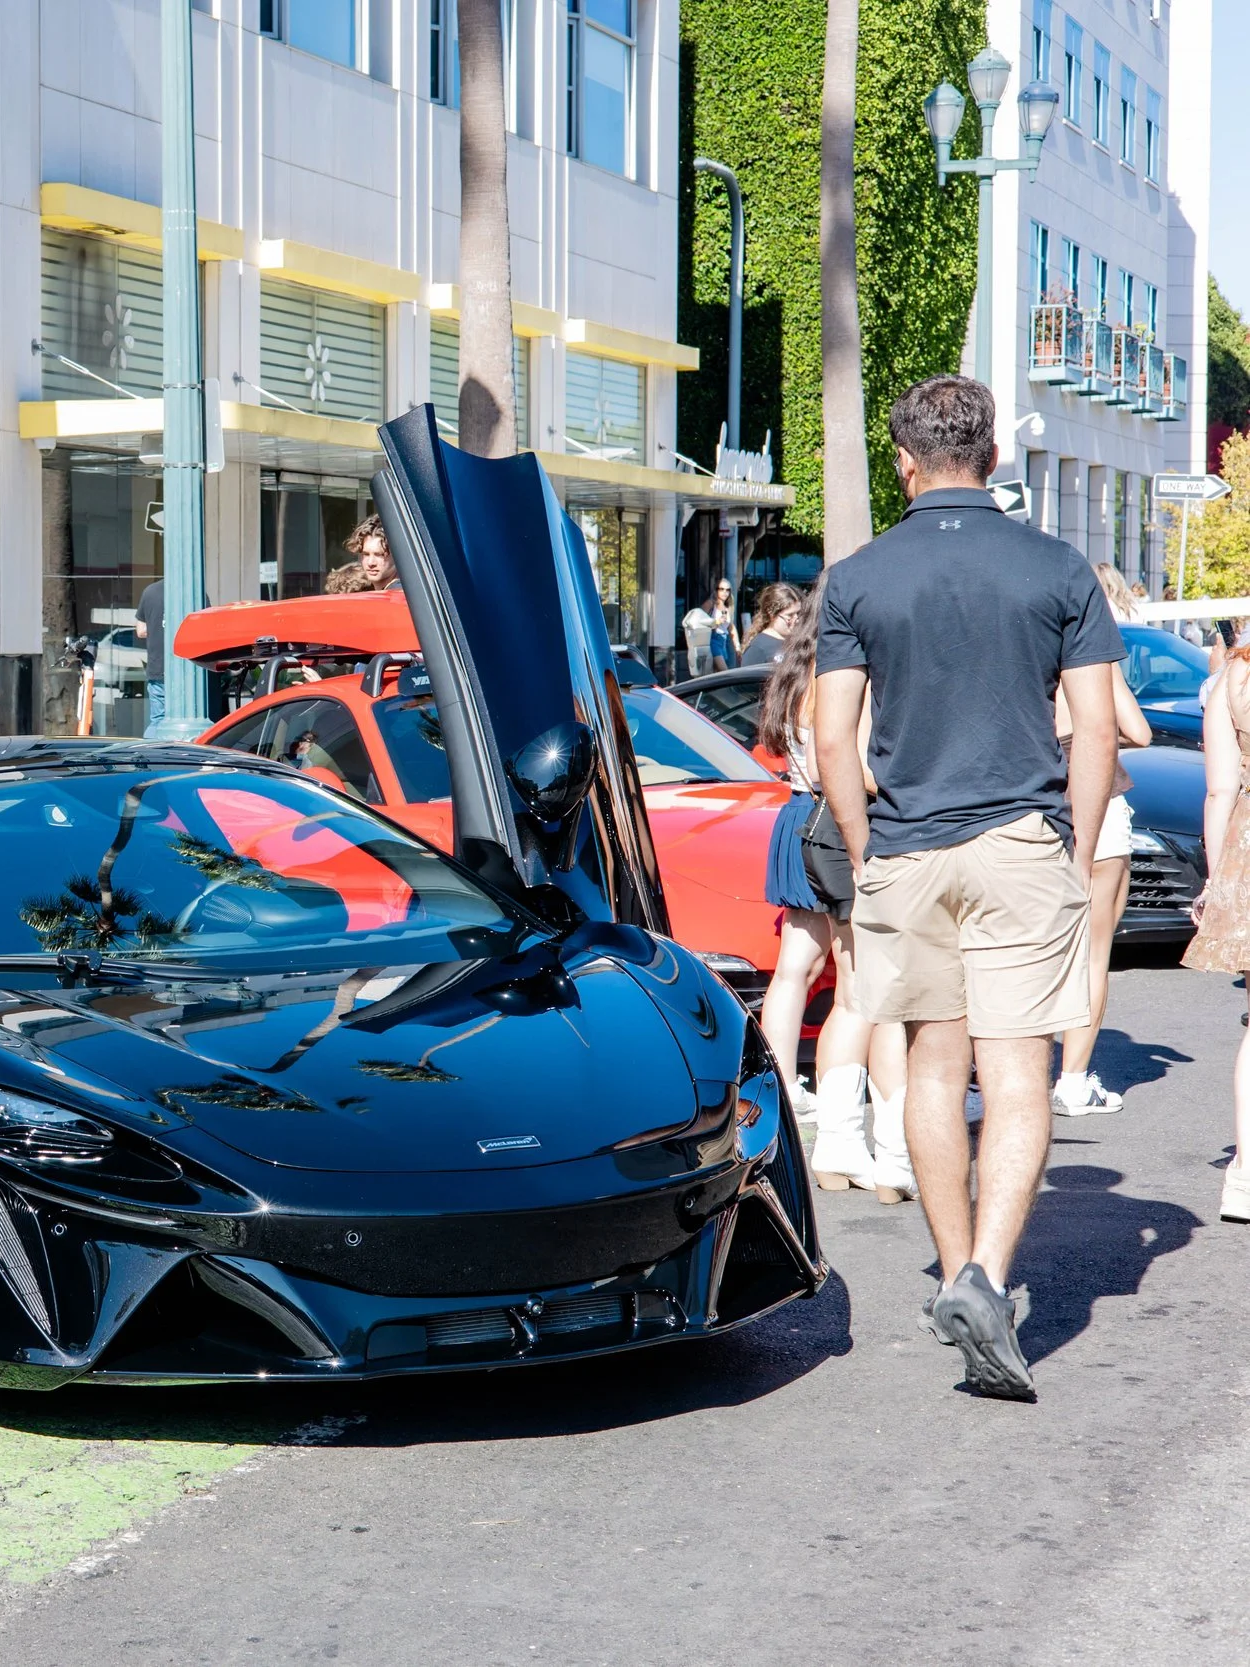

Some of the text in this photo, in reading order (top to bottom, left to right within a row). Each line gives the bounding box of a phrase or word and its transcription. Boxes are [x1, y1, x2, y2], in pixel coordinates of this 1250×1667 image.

[1161, 482, 1206, 492] ONE WAY
[485, 1139, 531, 1148] McLaren
